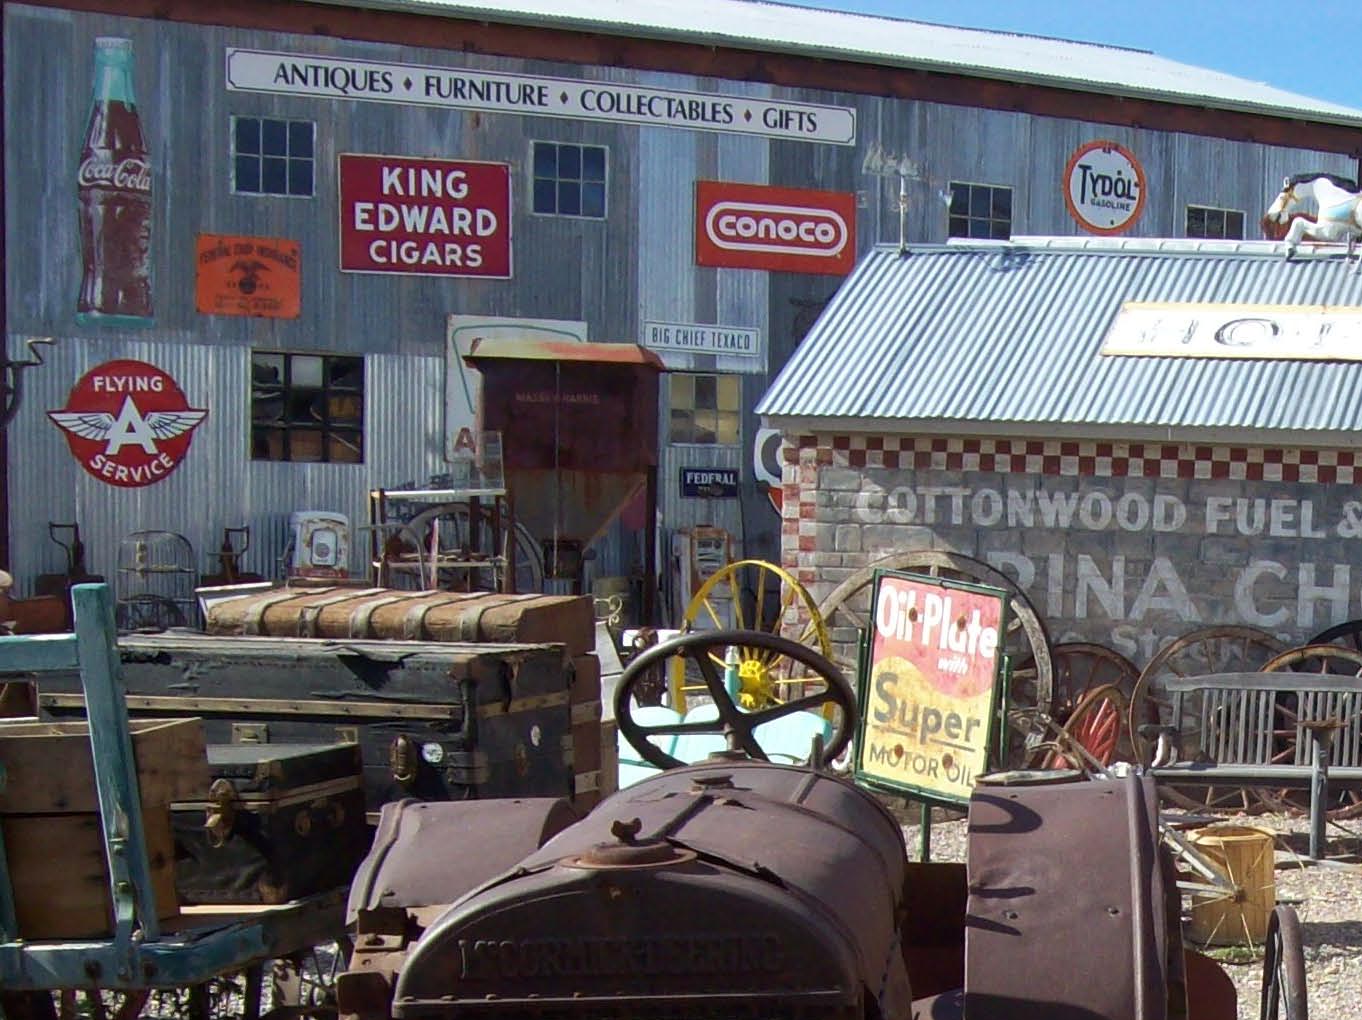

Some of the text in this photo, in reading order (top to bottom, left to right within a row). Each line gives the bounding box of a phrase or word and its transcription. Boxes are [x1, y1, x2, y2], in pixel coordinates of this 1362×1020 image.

[274, 62, 817, 133] ANTIQUES FURNITURE COLLECTABLES GIFTS
[78, 158, 151, 190] Coca-Cola
[382, 167, 469, 198] KING
[1078, 164, 1137, 205] TYDOL
[354, 202, 497, 237] EDWARD
[369, 240, 483, 267] CIGARS
[652, 329, 751, 350] BIG CHIEF TEXACO
[94, 375, 164, 392] FLYING
[104, 394, 159, 456] A
[90, 452, 174, 483] SERVICE
[686, 471, 736, 485] FEDERAL
[856, 486, 1187, 533] COTTONWOOD
[1205, 496, 1326, 538] FUEL
[985, 547, 1203, 622] RINA
[937, 656, 969, 675] with
[873, 670, 982, 746] Super
[868, 744, 976, 788] MOTOR OIL
